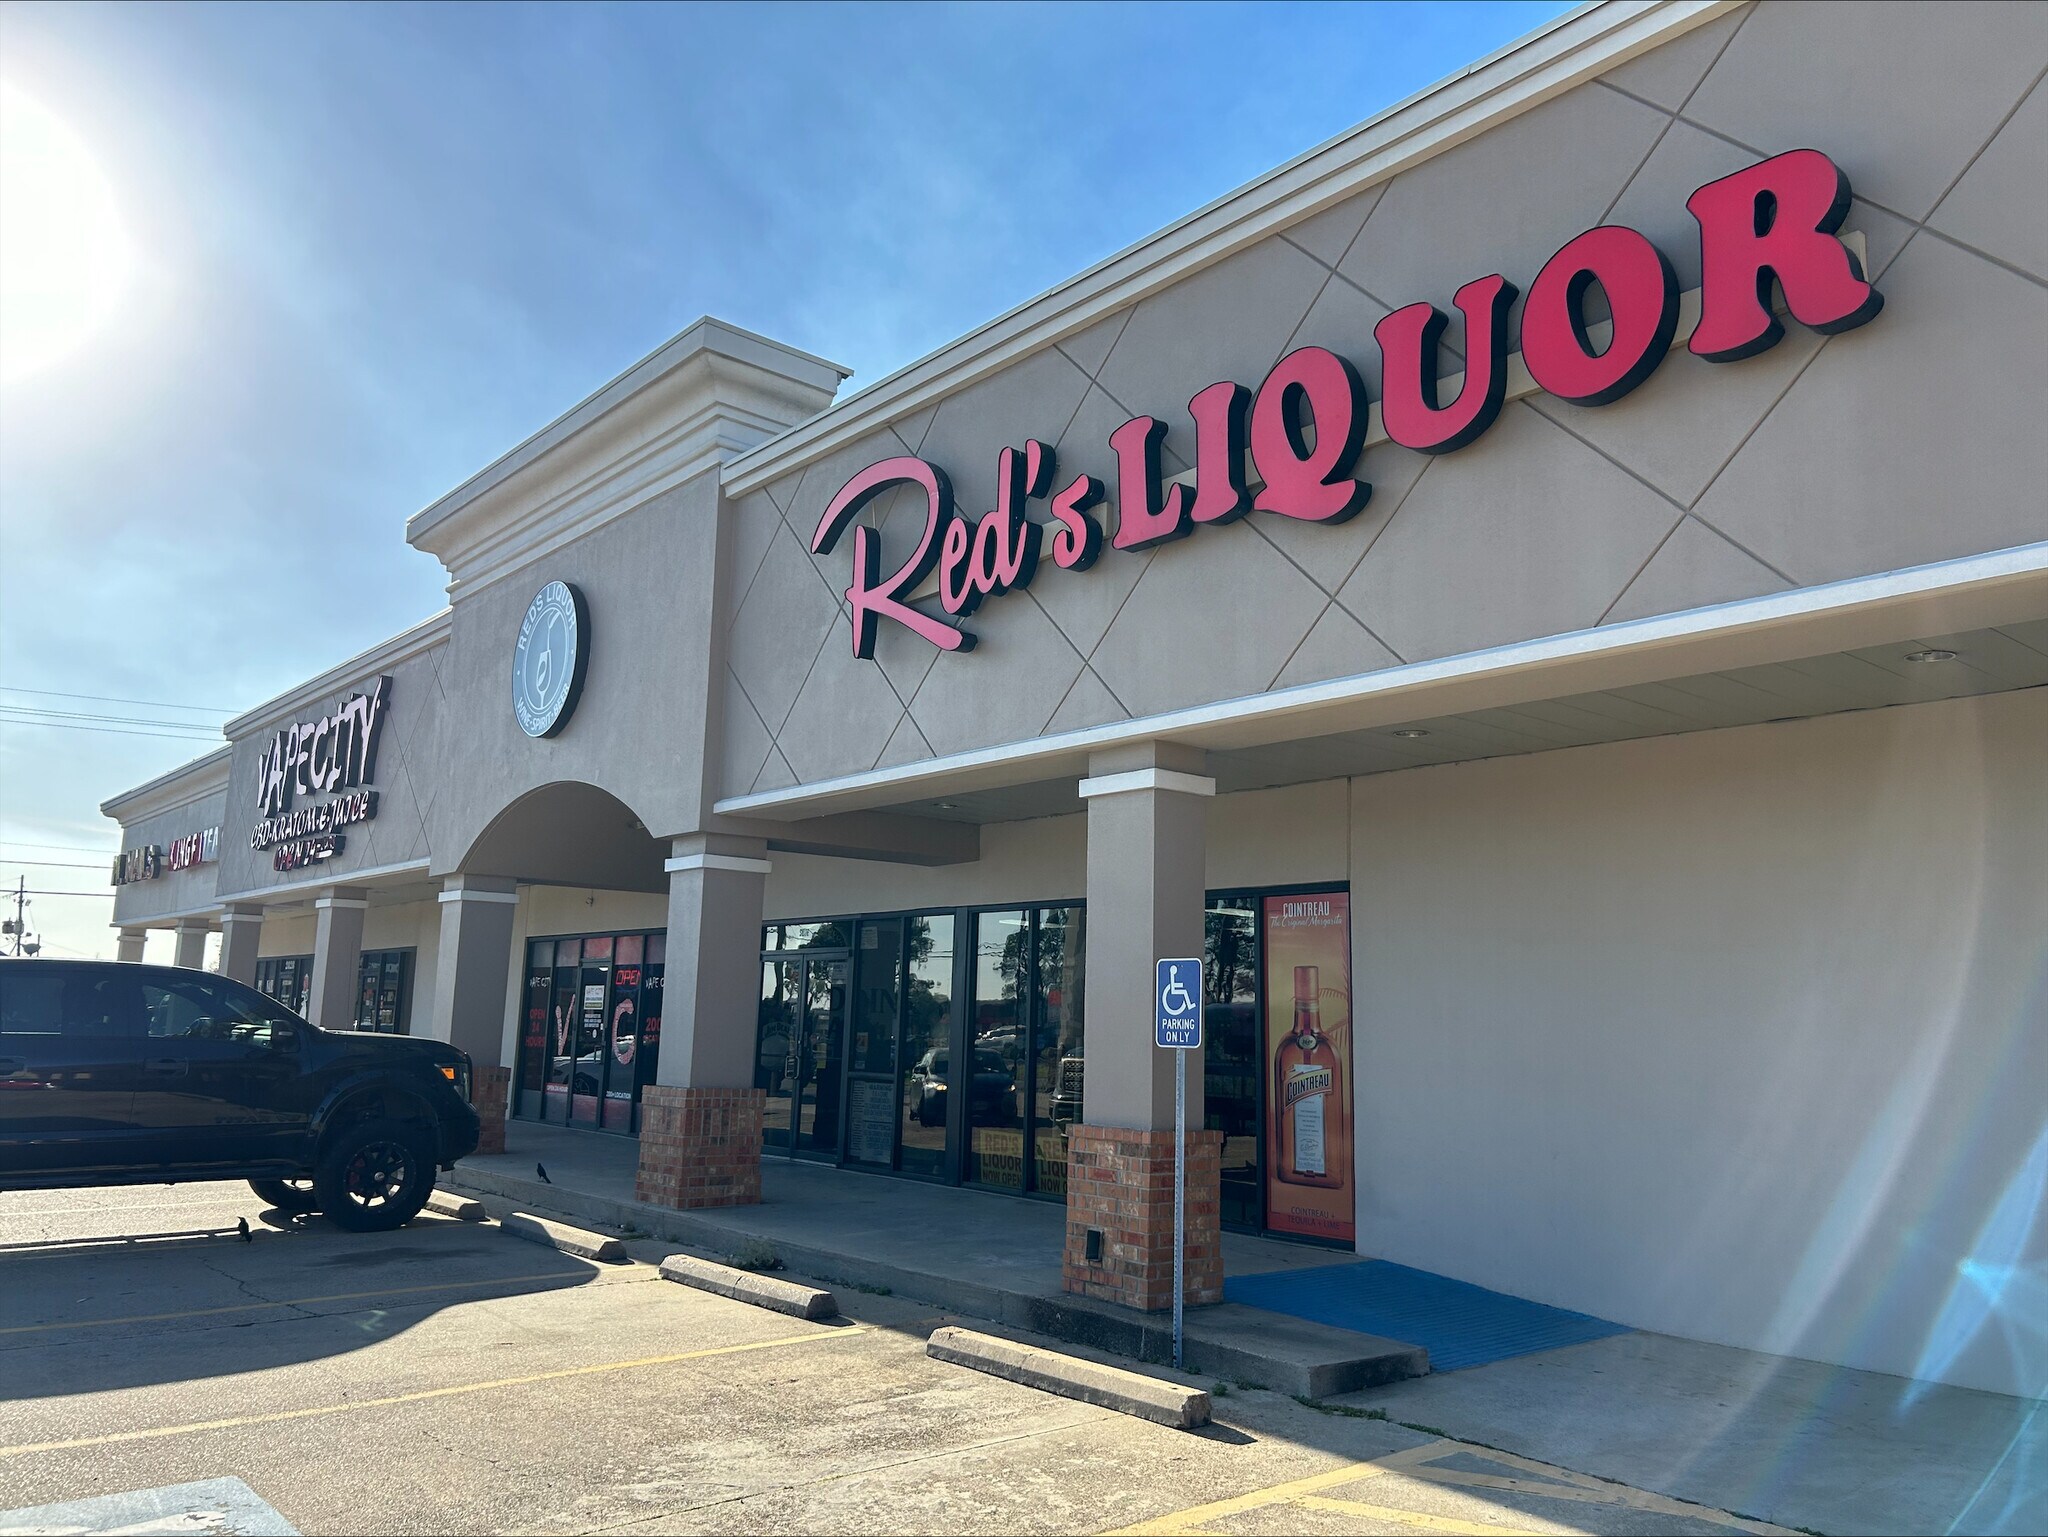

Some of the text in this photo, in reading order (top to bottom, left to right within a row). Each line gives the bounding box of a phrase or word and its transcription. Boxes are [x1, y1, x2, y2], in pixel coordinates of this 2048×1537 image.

[811, 148, 1884, 660] Red's LIQUOR
[518, 583, 577, 651] REDS LIQUOR
[1282, 901, 1330, 918] COINTREAU
[1307, 913, 1343, 929] Margarita
[1162, 1018, 1195, 1030] PARKING
[1166, 1031, 1190, 1043] ONLY
[1286, 1073, 1330, 1103] COINTREAU
[984, 1133, 1019, 1154] RED'S
[982, 1153, 1022, 1173] LIQUOR
[982, 1169, 1001, 1183] NOW
[1040, 1177, 1061, 1193] NOW
[1290, 1206, 1329, 1219] COINTREAU
[1287, 1215, 1317, 1227] TEQUILA
[1323, 1218, 1341, 1231] LIME
